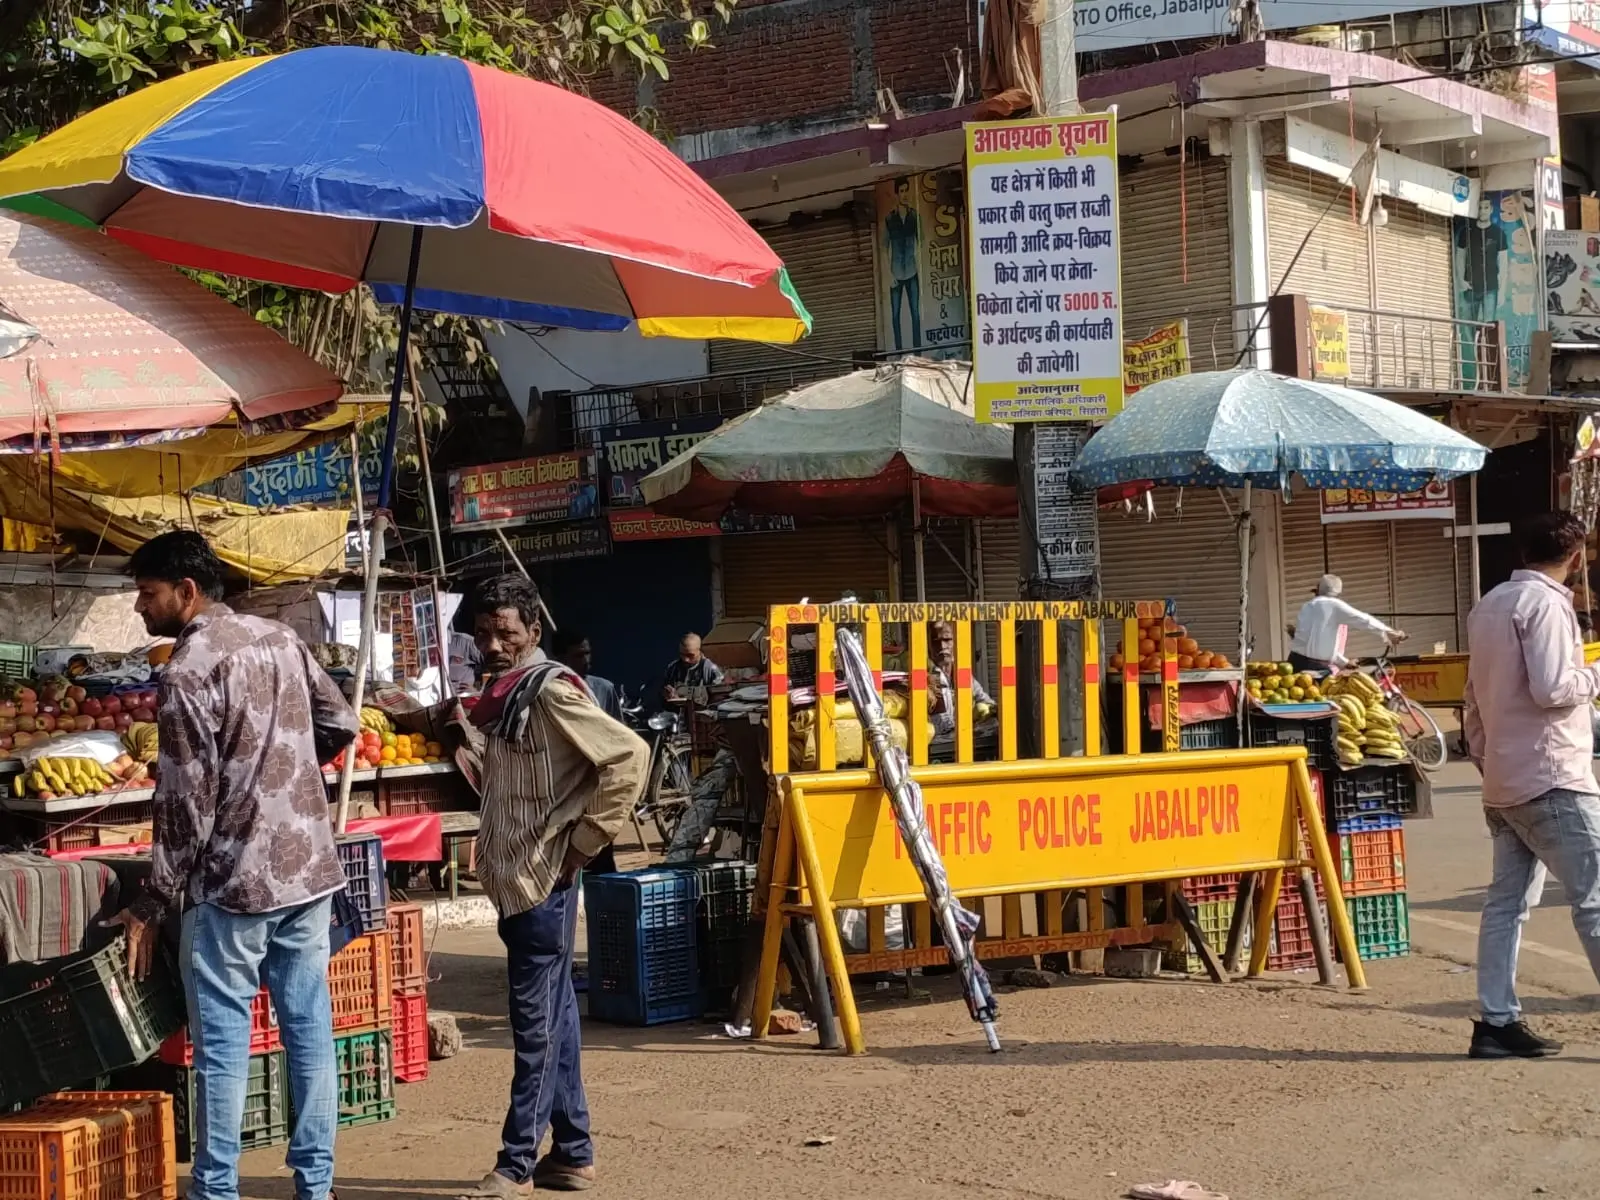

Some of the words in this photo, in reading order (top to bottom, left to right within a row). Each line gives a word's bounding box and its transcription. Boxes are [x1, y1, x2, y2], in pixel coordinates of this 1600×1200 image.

[1105, 2, 1157, 24] Office,
[974, 124, 1053, 153] आवश्यक
[1057, 119, 1109, 156] सूचना
[990, 175, 1008, 194] यह
[1011, 169, 1031, 192] क्षेत्र
[1031, 166, 1045, 191] में
[1047, 165, 1078, 190] किसी
[1081, 164, 1096, 188] भी
[977, 205, 1008, 225] प्रकार
[1010, 200, 1025, 223] की
[1028, 203, 1053, 228] वस्तु
[1053, 202, 1077, 221] फल
[1080, 193, 1111, 219] सब्जी
[980, 230, 1018, 255] सामग्री
[1021, 228, 1050, 253] आदि
[1052, 226, 1112, 251] क्रय-विक्रय
[994, 260, 1018, 285] किये
[1022, 259, 1047, 283] जाने
[1050, 263, 1065, 282] पर
[976, 291, 1012, 317] विक्रेता
[1016, 289, 1044, 314] दोनों
[1045, 293, 1060, 313] पर
[1063, 291, 1099, 312] 5000
[982, 323, 995, 346] के
[997, 320, 1042, 346] अर्थदण्ड
[1045, 319, 1060, 343] की
[1063, 316, 1113, 342] कार्यवाही
[1017, 351, 1032, 375] की
[819, 603, 870, 623] PUBLIC
[876, 603, 925, 623] WORKS
[926, 602, 1010, 622] DEPARTMENT
[1072, 600, 1137, 619] JABALPUR
[889, 799, 993, 860] TAFFIC
[1018, 793, 1103, 851] POLICE
[1129, 783, 1241, 844] JABALPUR
